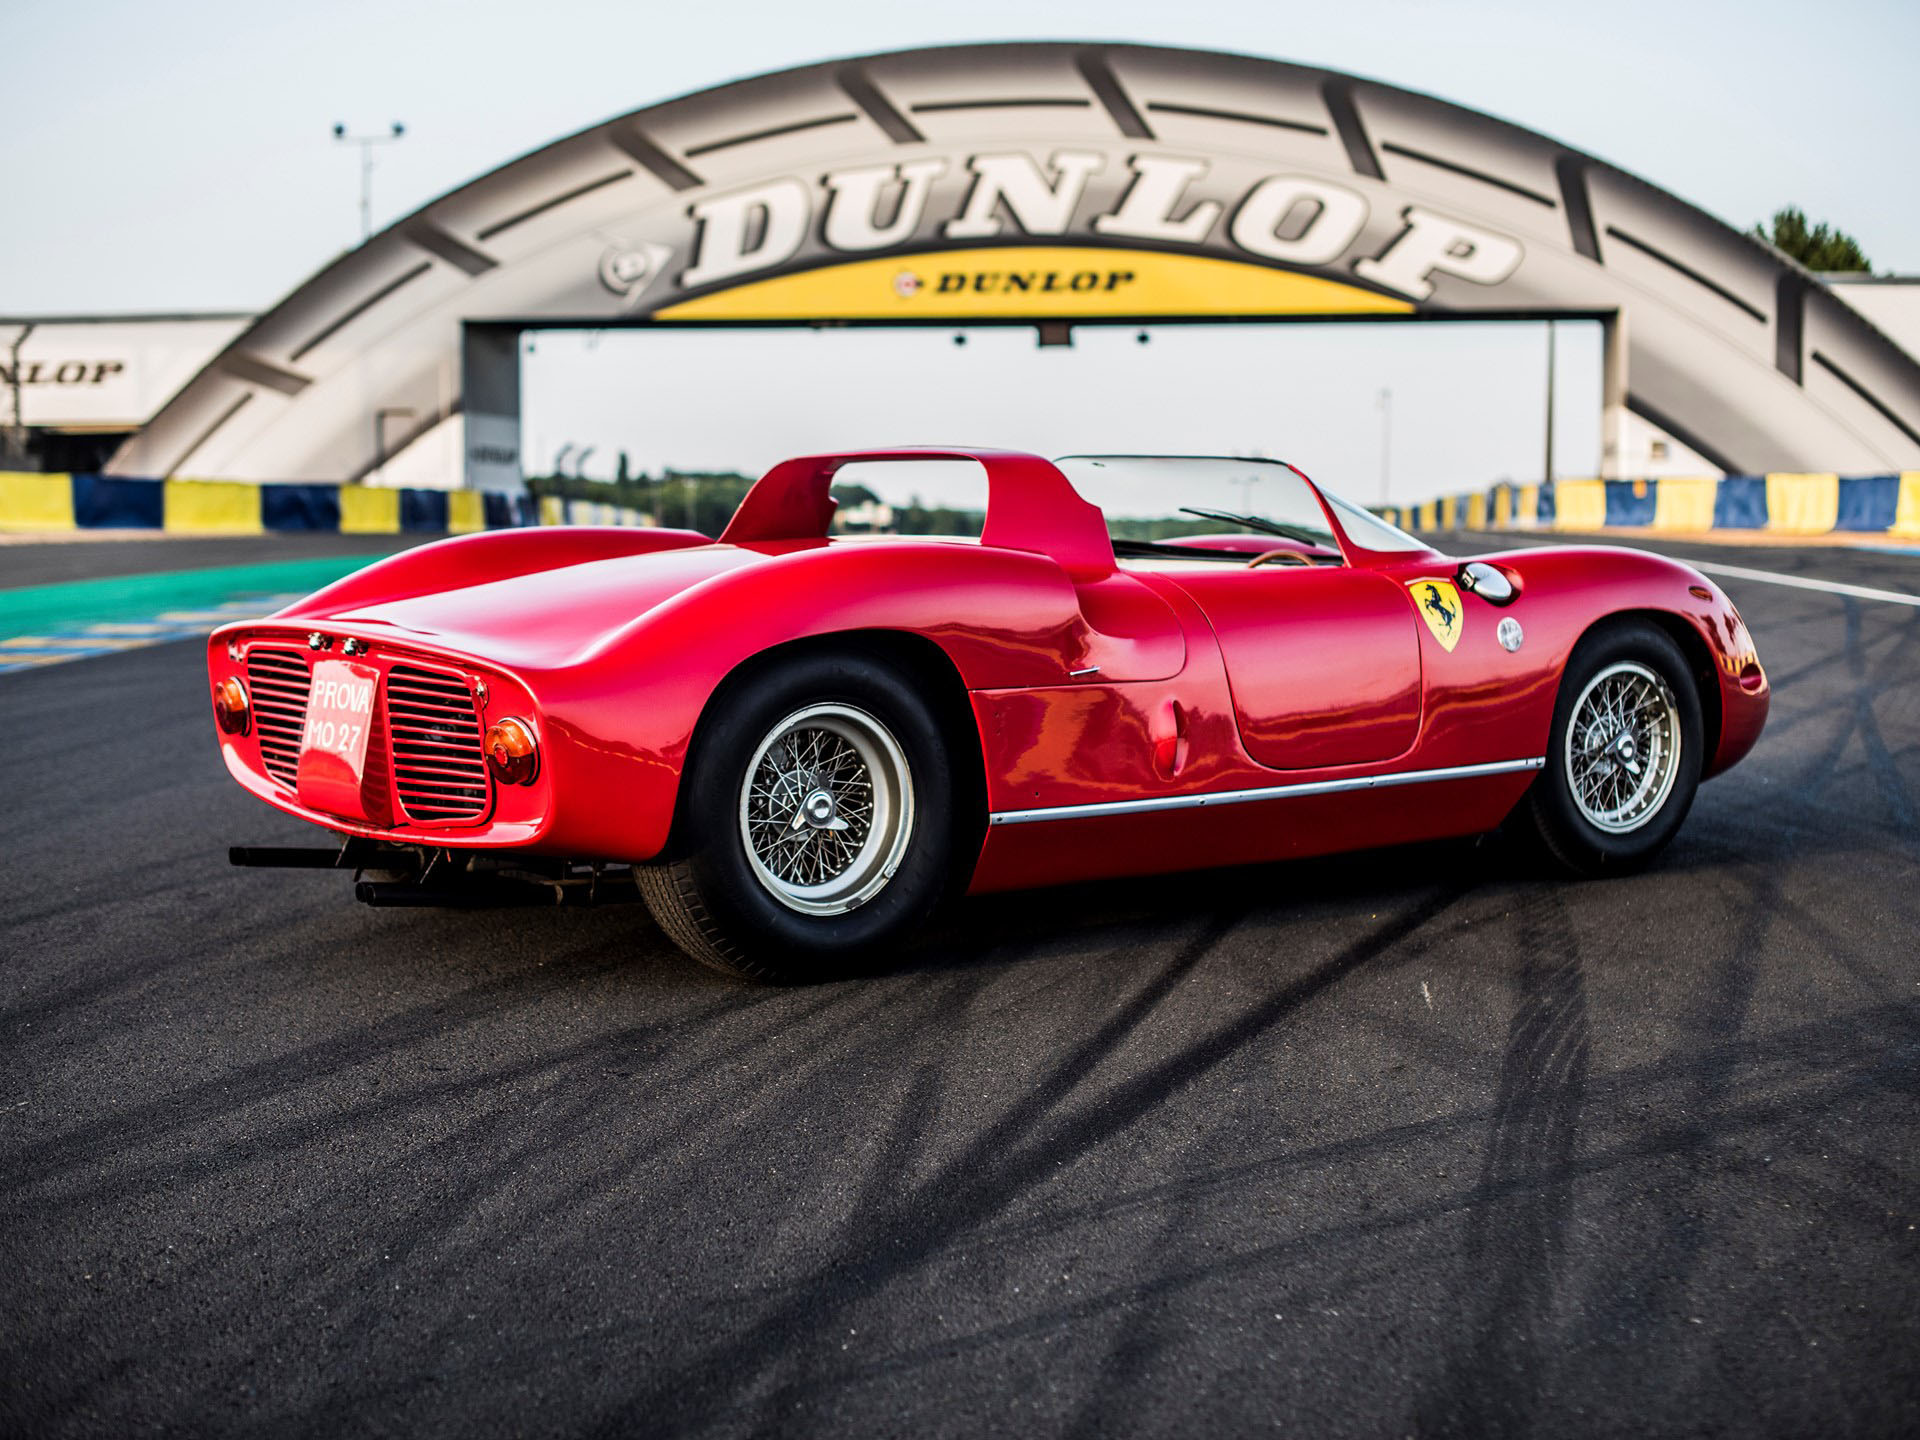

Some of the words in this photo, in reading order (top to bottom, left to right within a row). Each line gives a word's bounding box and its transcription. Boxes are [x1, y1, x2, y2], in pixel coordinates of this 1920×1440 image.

[680, 150, 1524, 301] DUNLOP
[936, 271, 1135, 294] DUNLOP
[312, 679, 370, 714] PROVA
[307, 718, 335, 748] MO
[337, 722, 361, 753] 27
